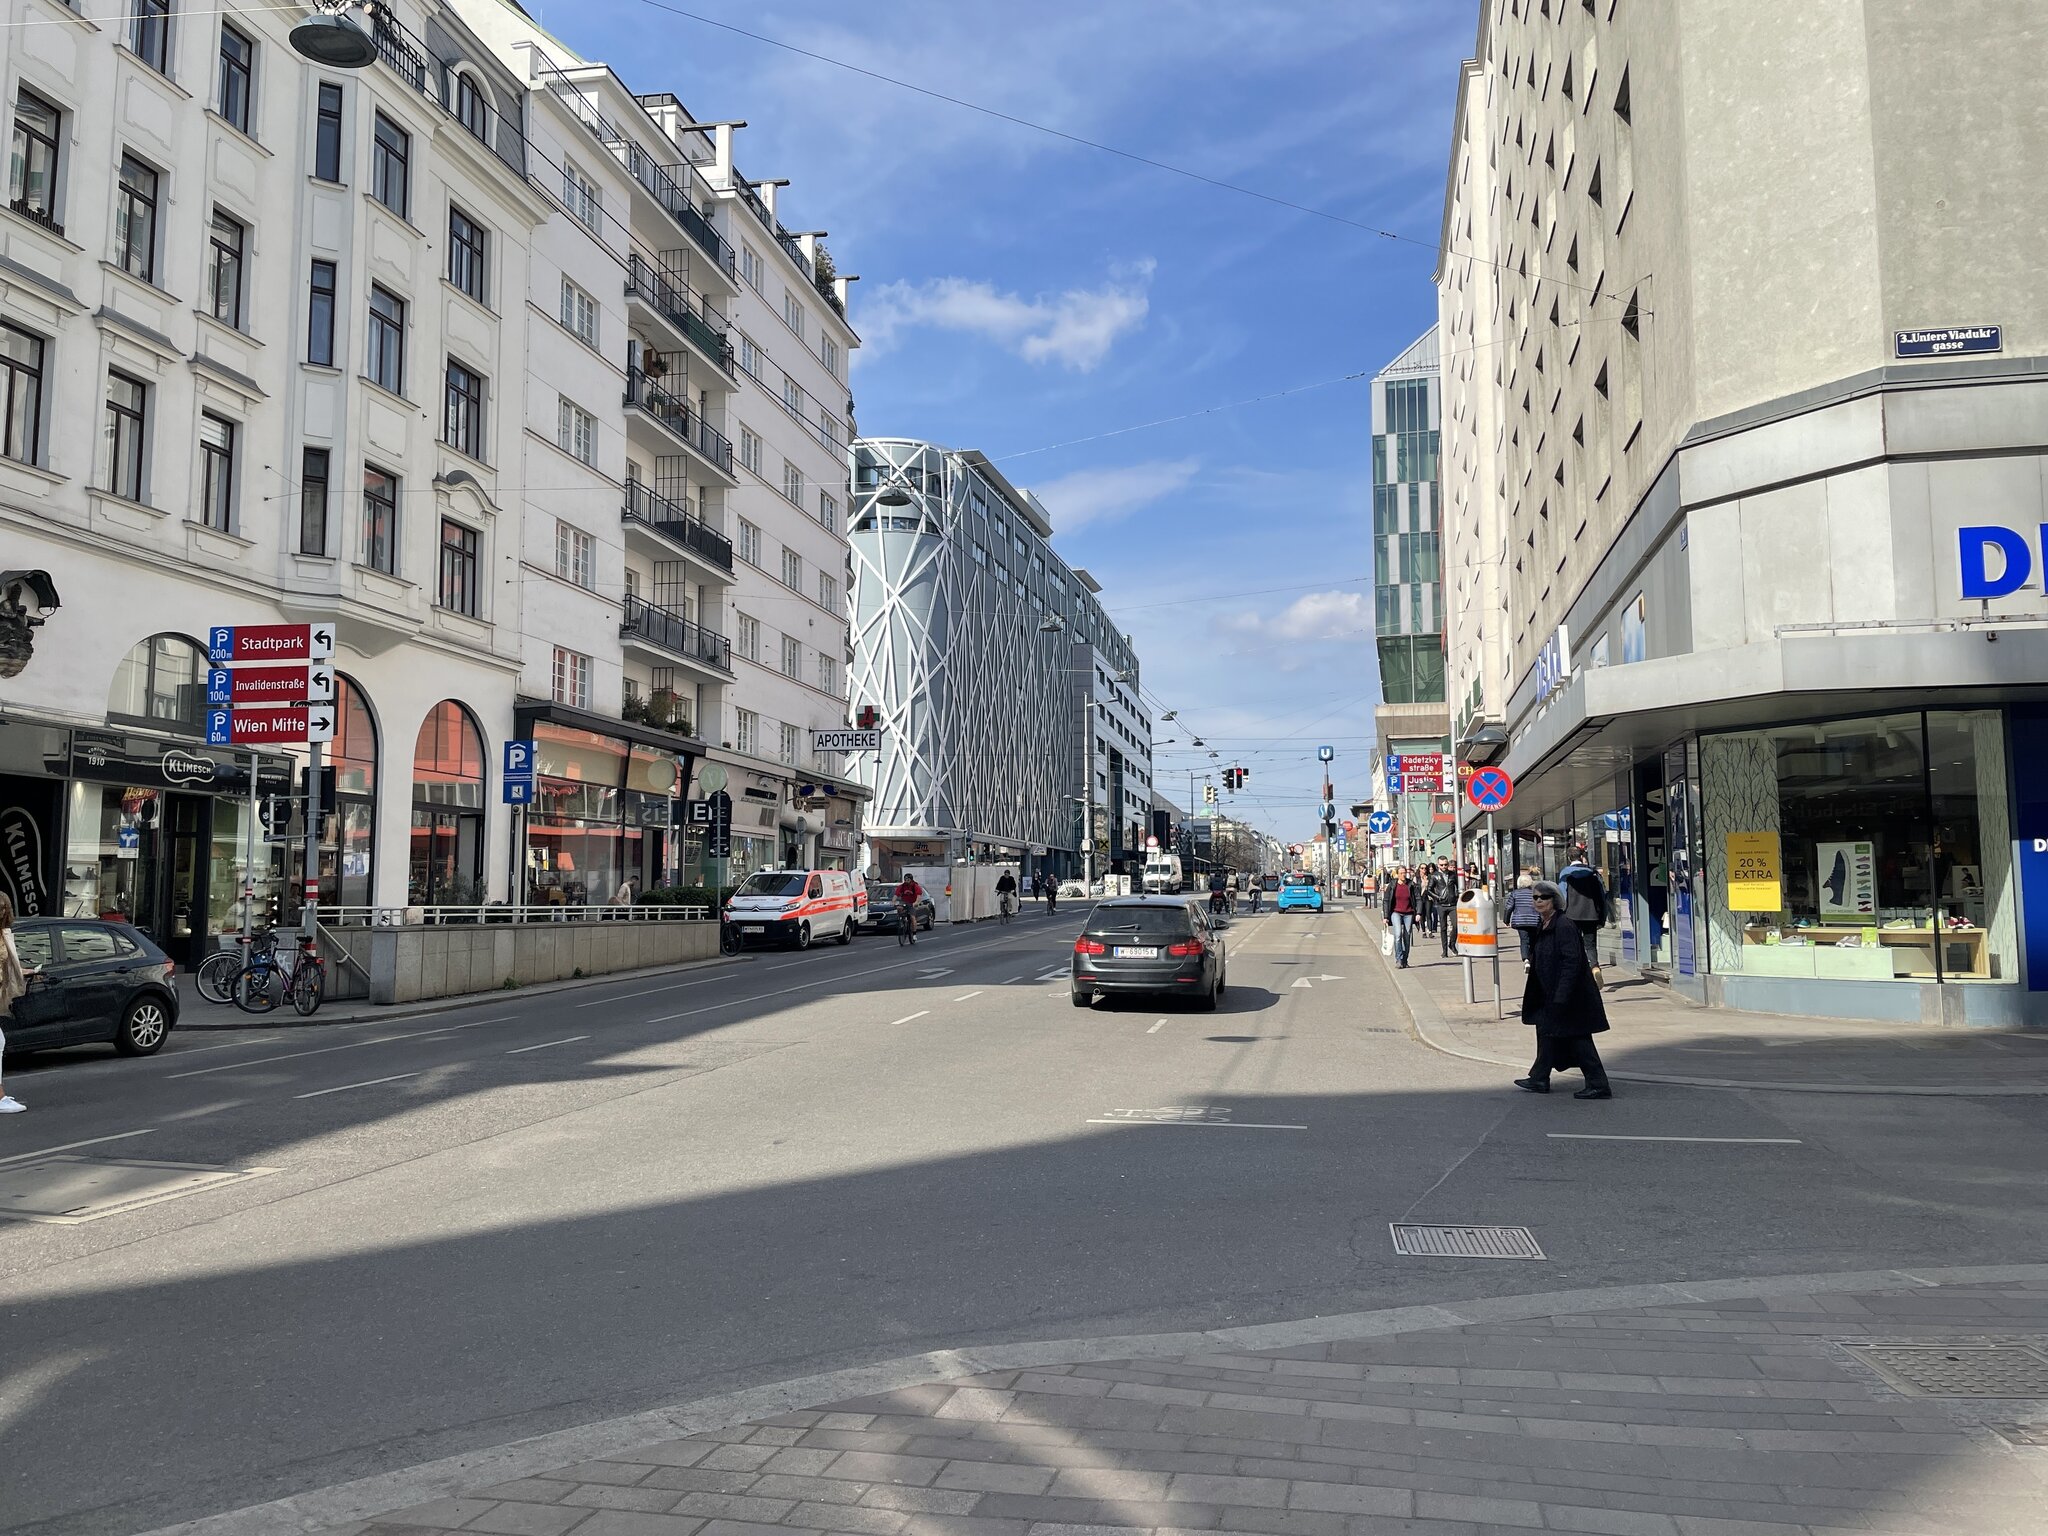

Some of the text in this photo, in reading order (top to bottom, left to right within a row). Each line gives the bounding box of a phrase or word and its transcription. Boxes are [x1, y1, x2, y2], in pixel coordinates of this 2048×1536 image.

[1932, 341, 1964, 353] gasse
[1955, 522, 2048, 600] D
[241, 636, 304, 652] Stadtpark
[235, 678, 305, 692] Invalidenstraße
[233, 717, 306, 733] Wien Mitte
[816, 733, 876, 748] APOTHEKE
[88, 756, 105, 767] 1910
[168, 758, 211, 774] KLIMESCH
[1402, 756, 1442, 766] Radetzky-
[1409, 764, 1434, 772] straße
[1478, 802, 1504, 811] ANFANG
[2033, 838, 2048, 853] D
[1739, 858, 1767, 868] 20 %
[1734, 869, 1773, 880] EXTRA
